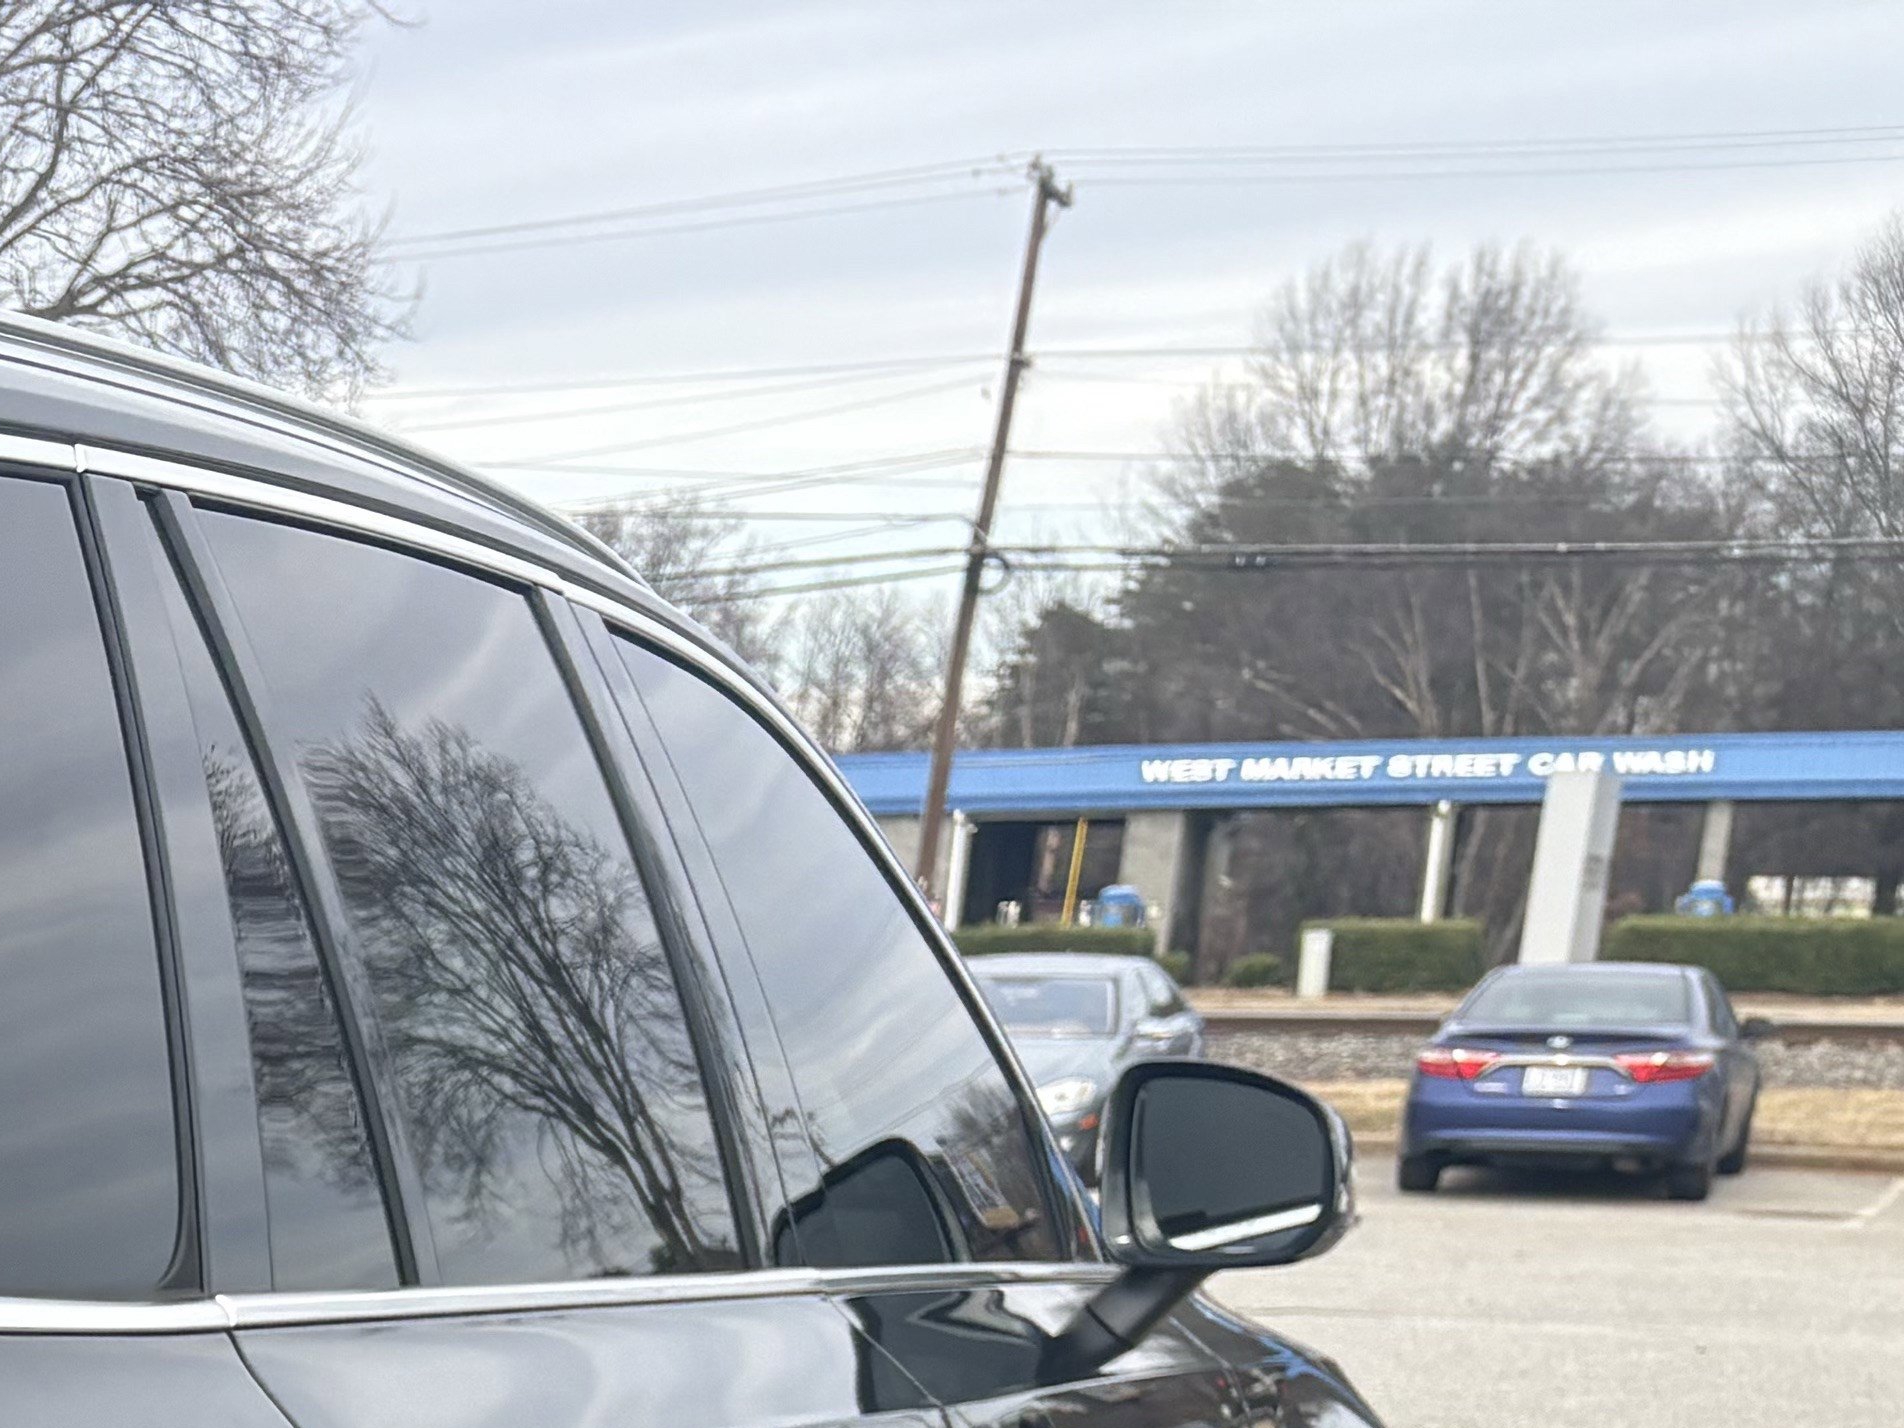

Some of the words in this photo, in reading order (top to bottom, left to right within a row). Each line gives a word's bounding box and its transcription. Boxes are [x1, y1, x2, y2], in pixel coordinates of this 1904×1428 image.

[1141, 758, 1237, 783] WEST
[1240, 755, 1383, 781] MARKET
[1386, 753, 1522, 778] STREET
[1528, 751, 1605, 776] CAR
[1612, 749, 1715, 774] WASH
